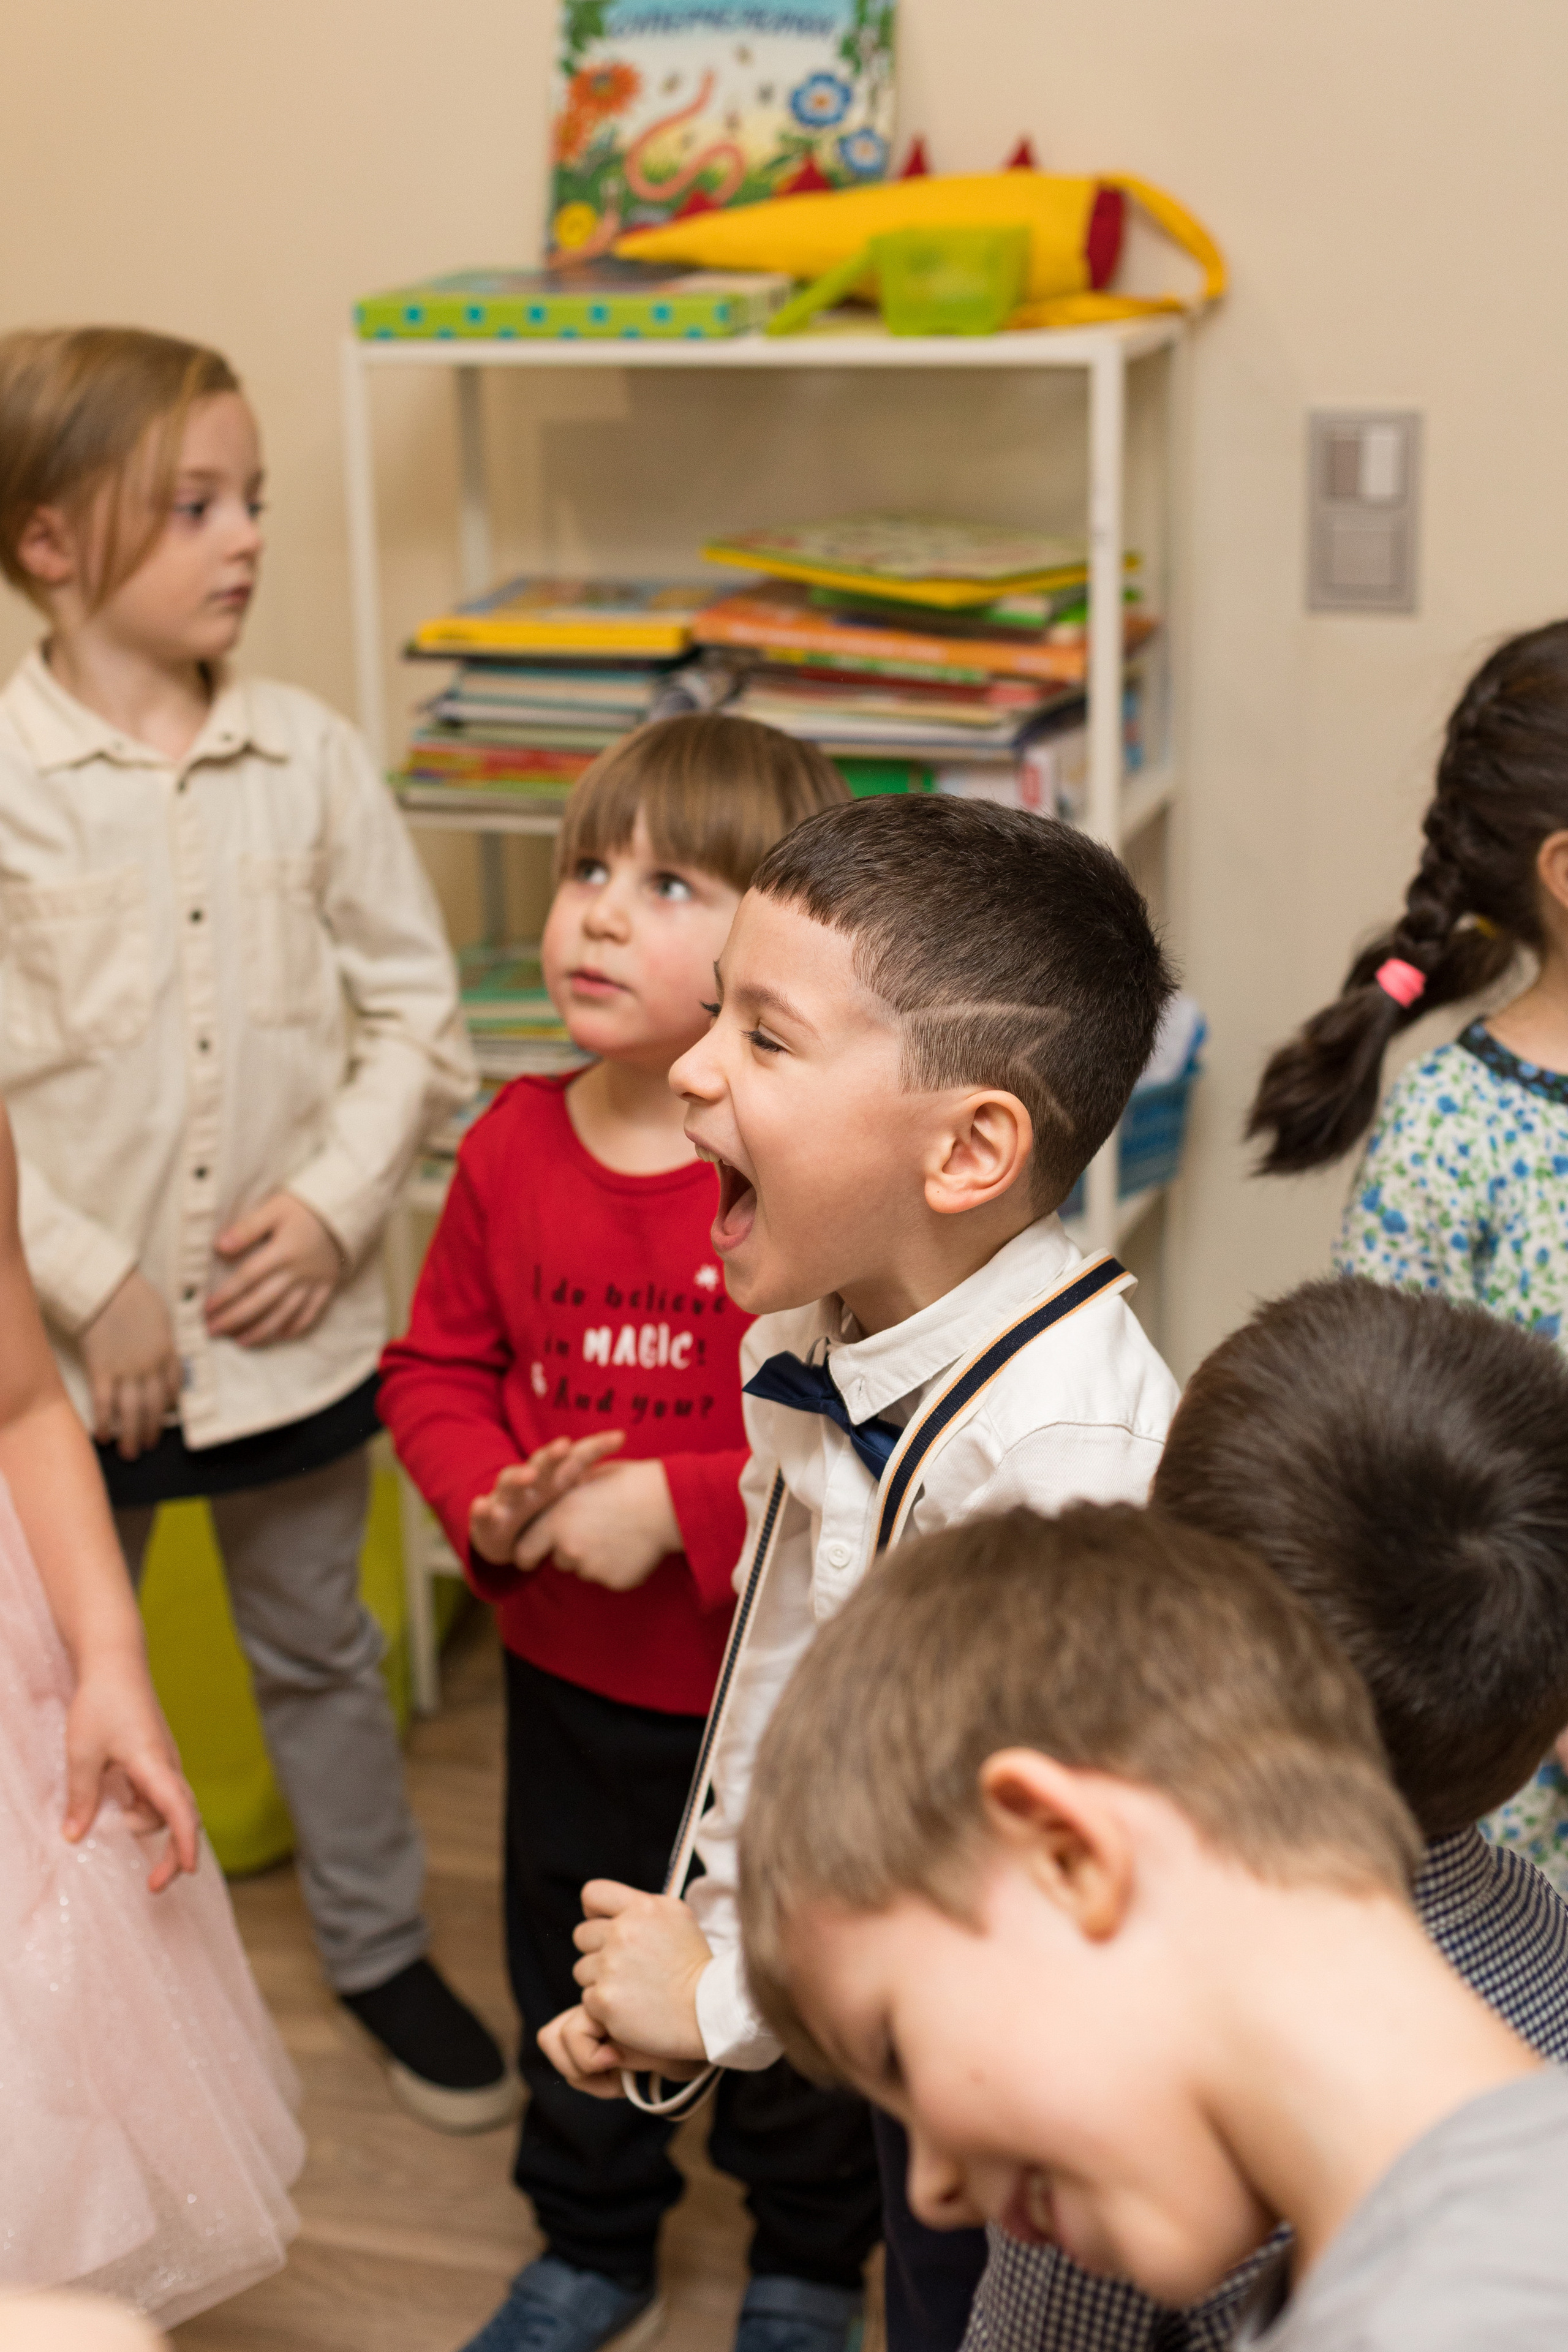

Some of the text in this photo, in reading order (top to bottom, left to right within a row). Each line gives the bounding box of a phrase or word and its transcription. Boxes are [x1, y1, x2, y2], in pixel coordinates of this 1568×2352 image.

[552, 1276, 586, 1306] do
[605, 1281, 728, 1316] believe
[544, 1332, 569, 1358] in
[553, 1375, 715, 1425] And you?
